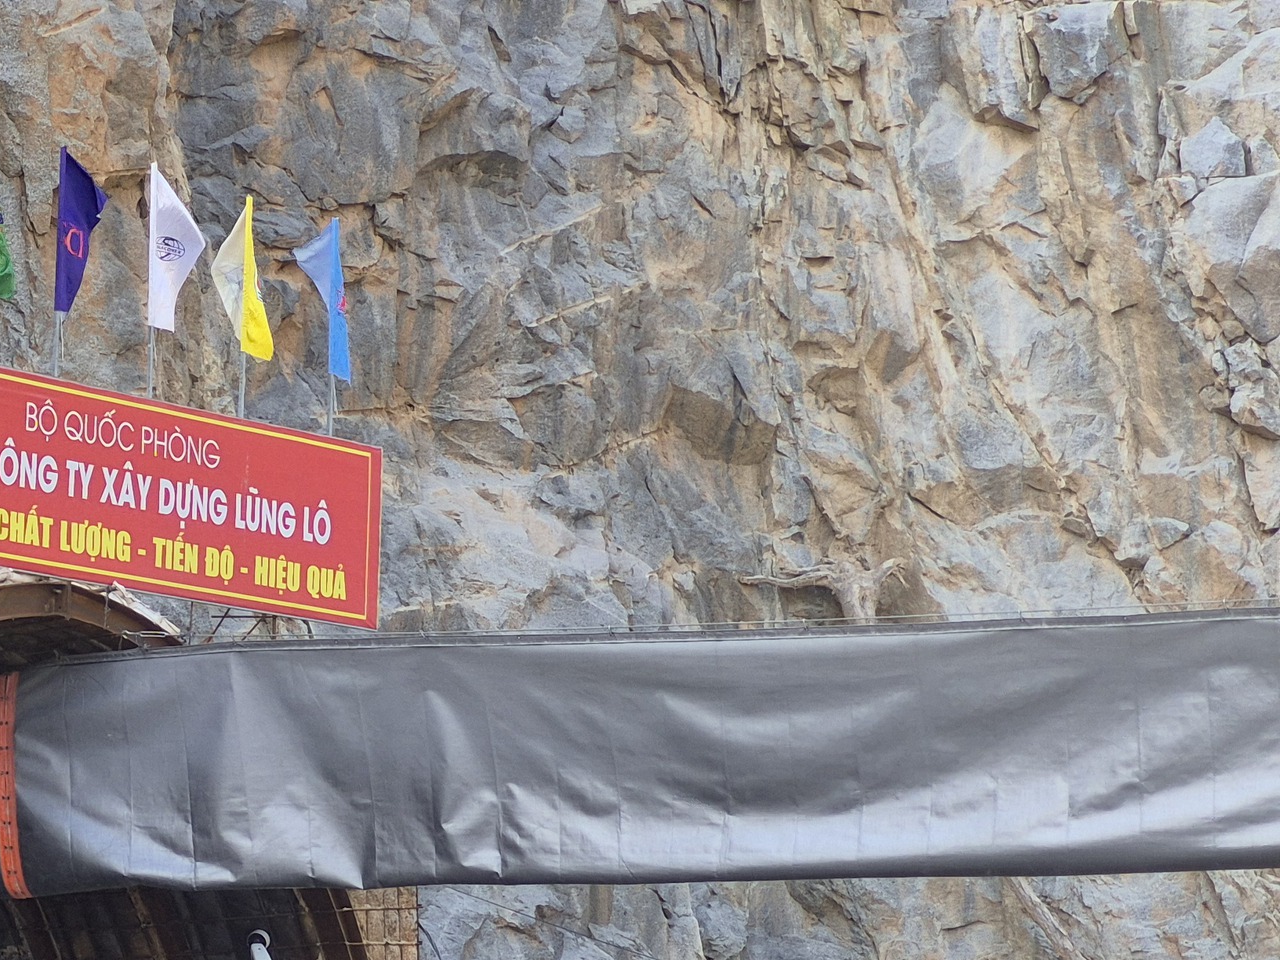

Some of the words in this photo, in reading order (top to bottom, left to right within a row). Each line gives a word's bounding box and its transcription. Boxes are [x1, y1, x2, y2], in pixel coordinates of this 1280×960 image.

[25, 399, 58, 442] BỘ
[64, 409, 135, 452] QUỐC
[141, 426, 221, 469] PHÒNG
[66, 459, 95, 500] TY
[100, 461, 152, 511] XÂY
[158, 478, 228, 529] DỰNG
[235, 486, 297, 538] LŨNG
[303, 499, 332, 545] LÔ
[59, 519, 132, 562] LƯỢNG
[153, 532, 199, 574] TIẾN
[204, 545, 235, 586] ĐỘ
[255, 555, 301, 595] HIỆU
[306, 563, 347, 601] QUẢ
